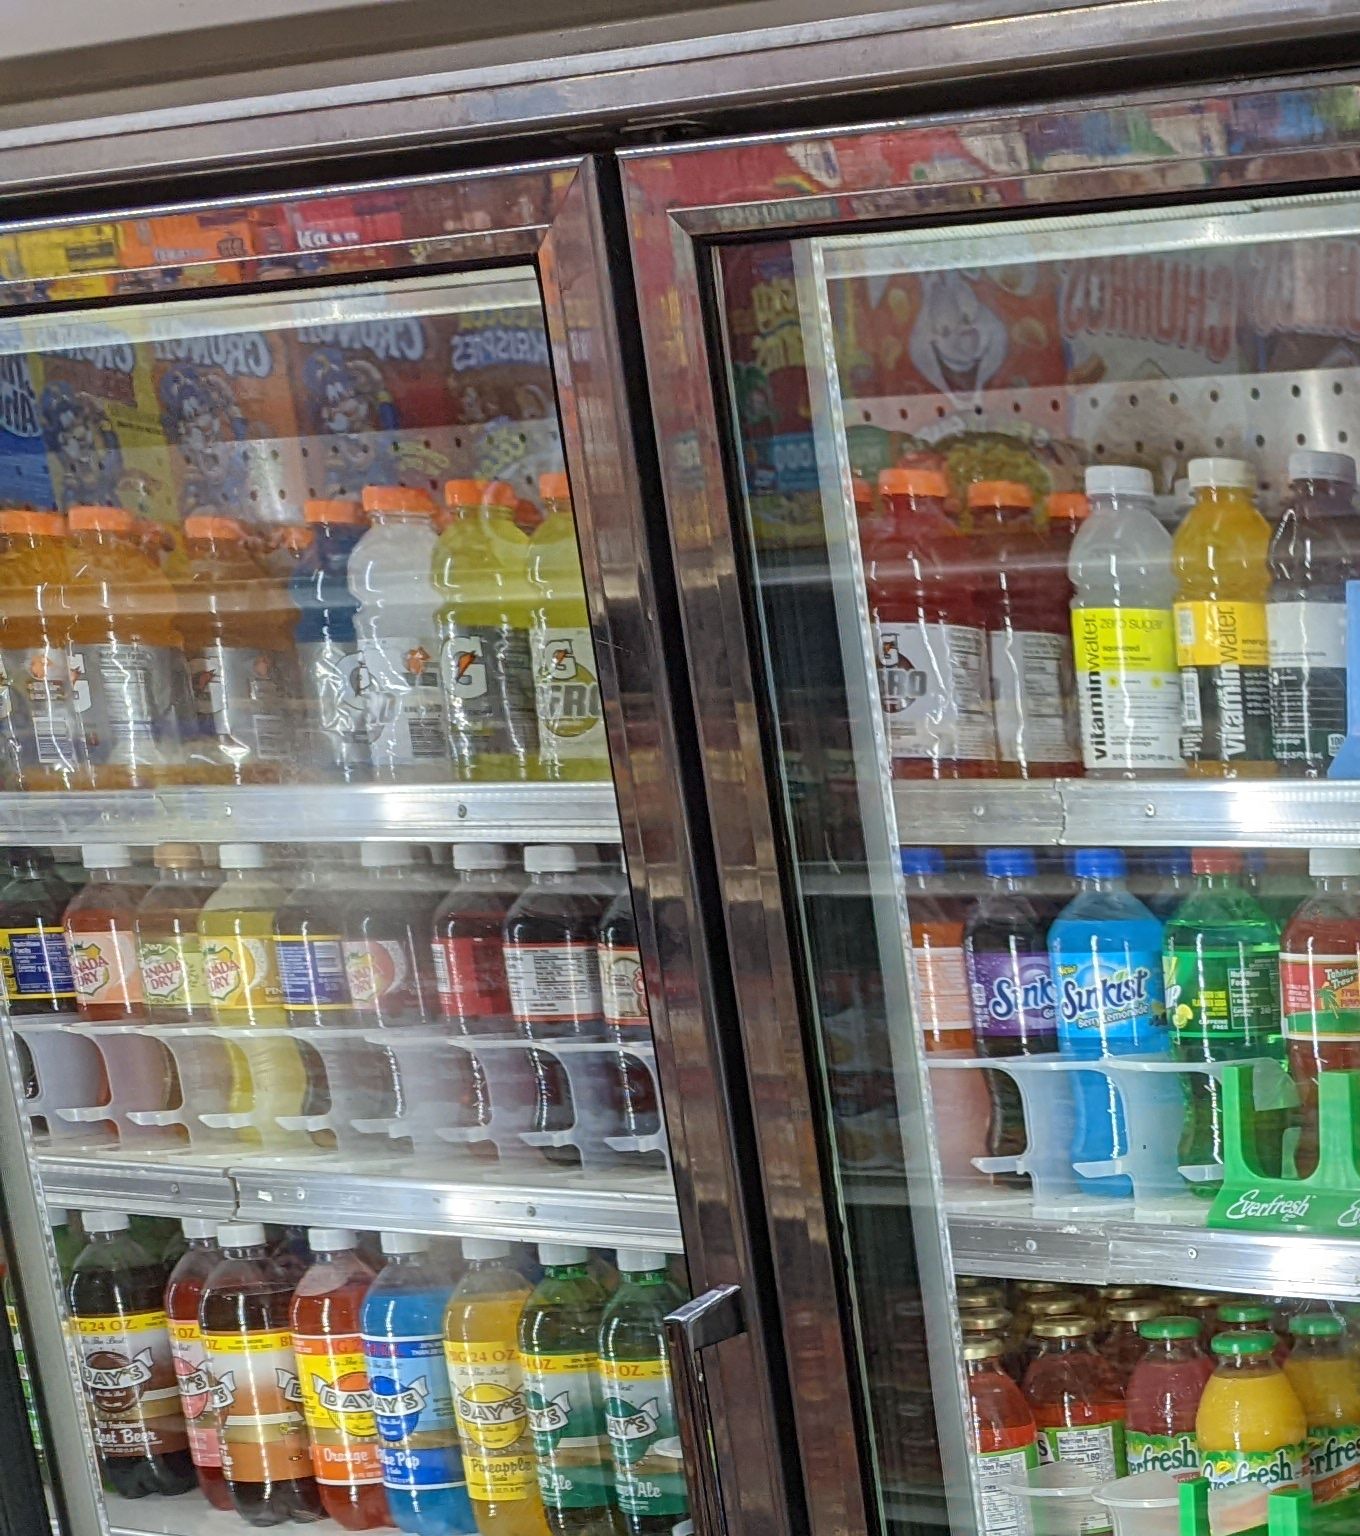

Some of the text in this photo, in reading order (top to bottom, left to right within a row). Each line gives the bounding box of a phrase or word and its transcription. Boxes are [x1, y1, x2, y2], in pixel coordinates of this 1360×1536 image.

[1061, 967, 1151, 1020] Sunkist
[1226, 1188, 1310, 1221] Everfresh
[460, 1397, 525, 1420] DAY'S
[324, 1449, 368, 1463] Orange
[471, 1458, 532, 1474] Pineapple
[638, 1482, 661, 1498] Ale
